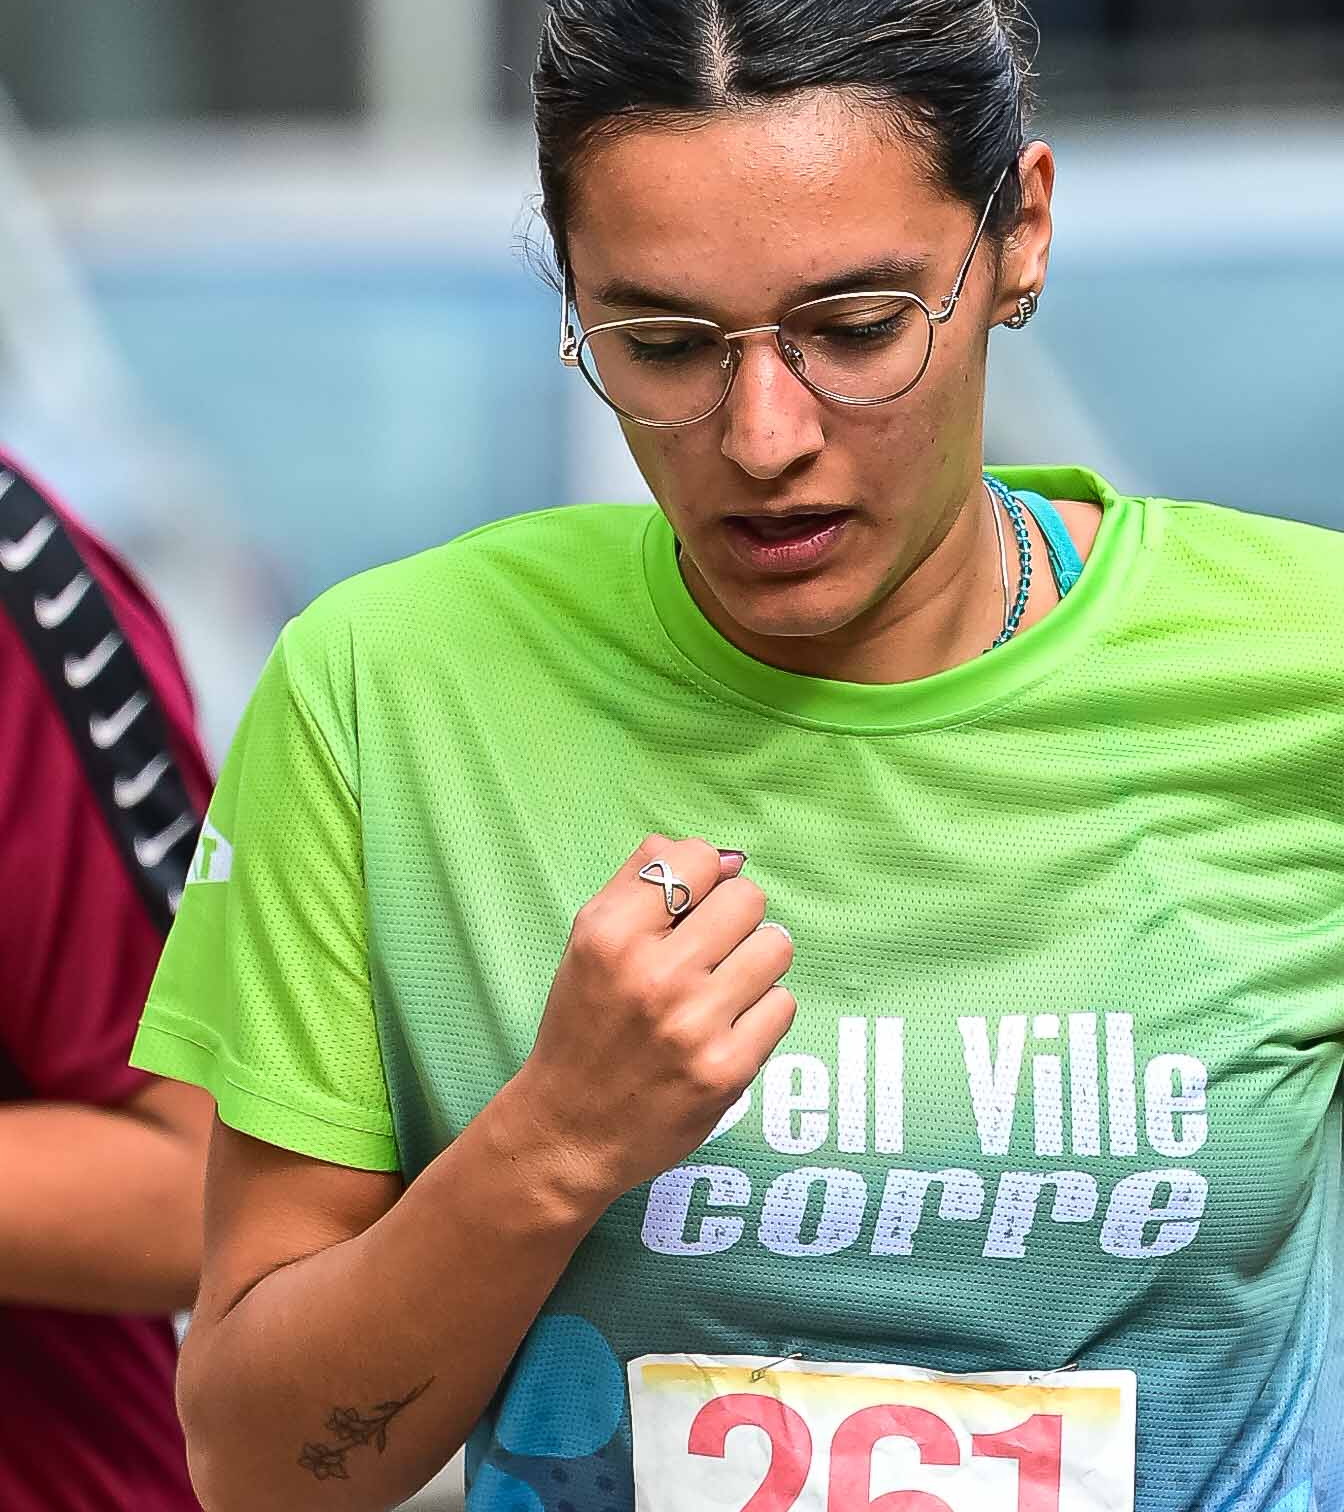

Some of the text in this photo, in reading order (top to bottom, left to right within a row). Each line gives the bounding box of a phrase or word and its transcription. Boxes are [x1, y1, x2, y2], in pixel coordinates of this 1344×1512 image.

[698, 1012, 1209, 1157] ell Ville
[640, 1164, 1209, 1258] corre
